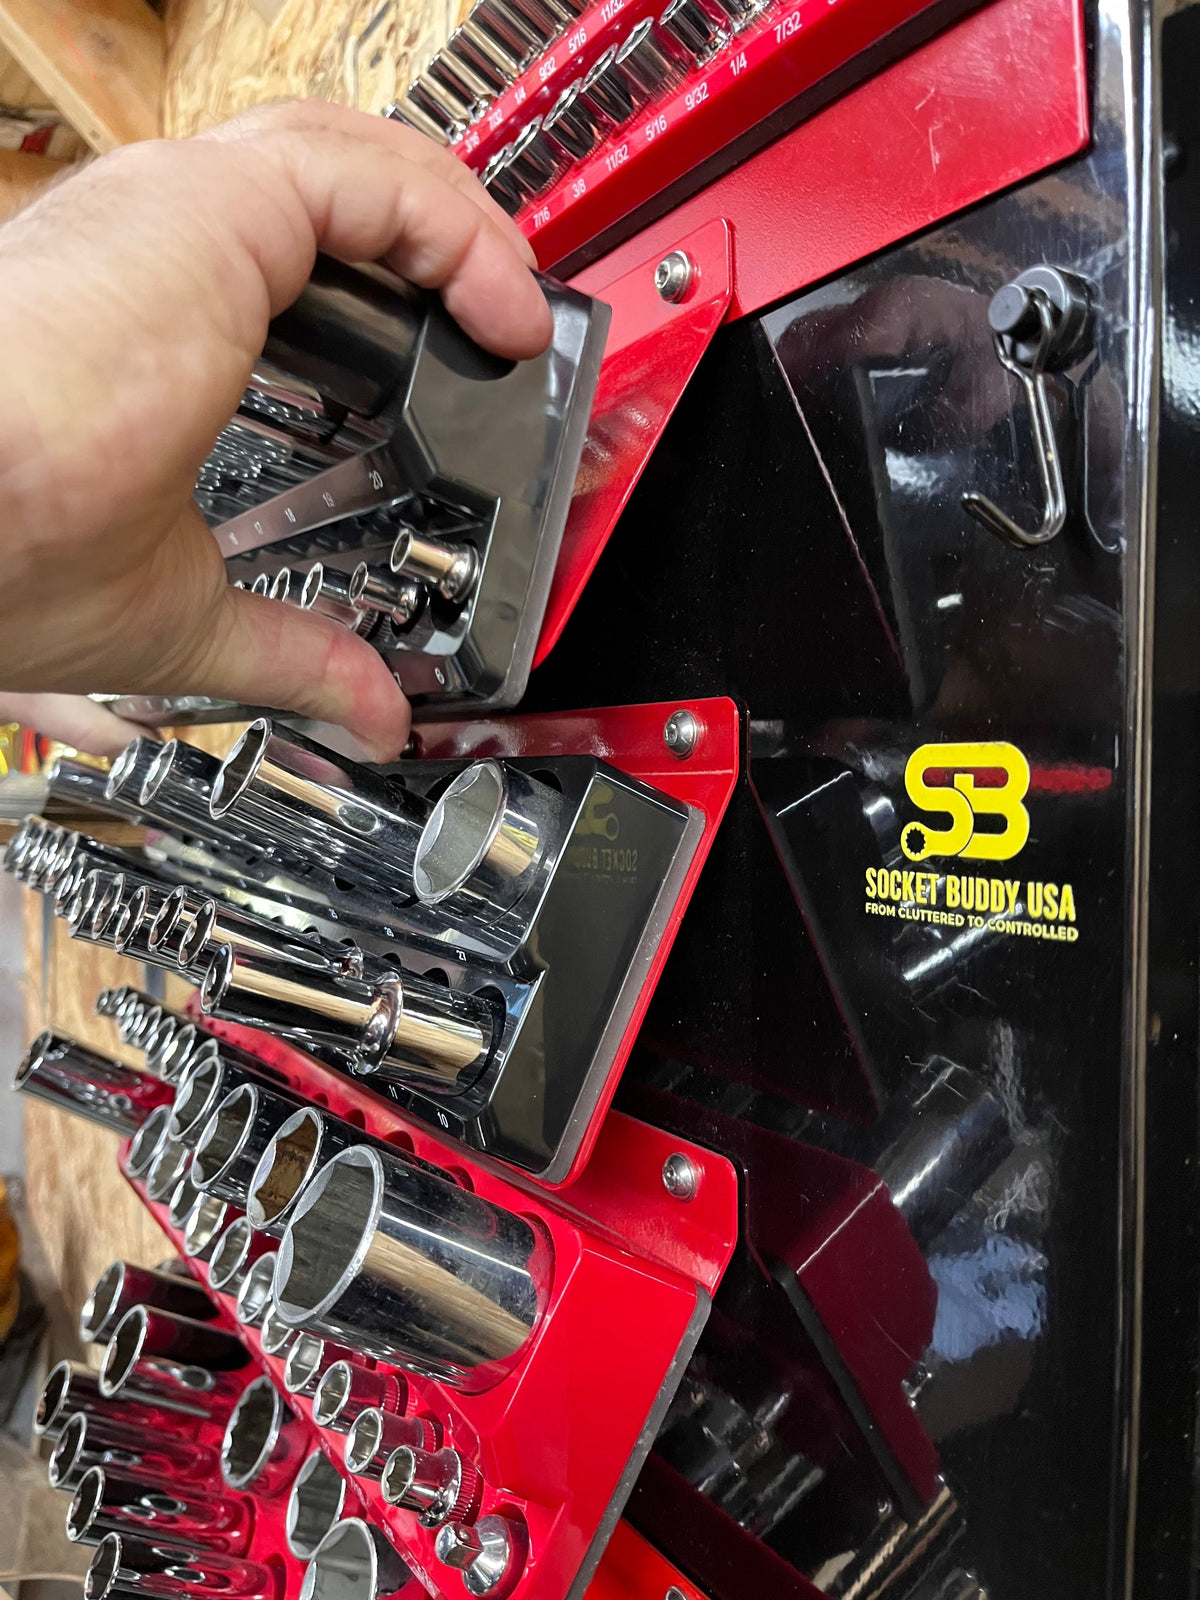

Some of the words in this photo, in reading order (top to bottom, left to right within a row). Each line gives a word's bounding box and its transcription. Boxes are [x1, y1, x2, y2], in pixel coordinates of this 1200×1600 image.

[514, 87, 526, 105] 1/4
[539, 62, 556, 81] 9/32
[568, 28, 586, 54] 5/16
[533, 207, 550, 228] 7/16
[572, 179, 586, 198] 3/8
[605, 145, 629, 171] 11/32
[645, 115, 667, 141] 5/16
[685, 82, 709, 111] 9/32
[730, 52, 747, 76] 1/4
[773, 12, 802, 43] 7/32
[369, 470, 383, 490] 20
[865, 867, 940, 905] SOCKET
[946, 874, 1020, 915] BUDDY
[1027, 881, 1076, 922] USA
[865, 902, 896, 917] FROM
[898, 906, 964, 927] CLUTTERED
[967, 914, 985, 929] TO
[987, 918, 1079, 942] CONTROLLED
[388, 1084, 399, 1100] 11
[437, 1111, 449, 1129] 10
